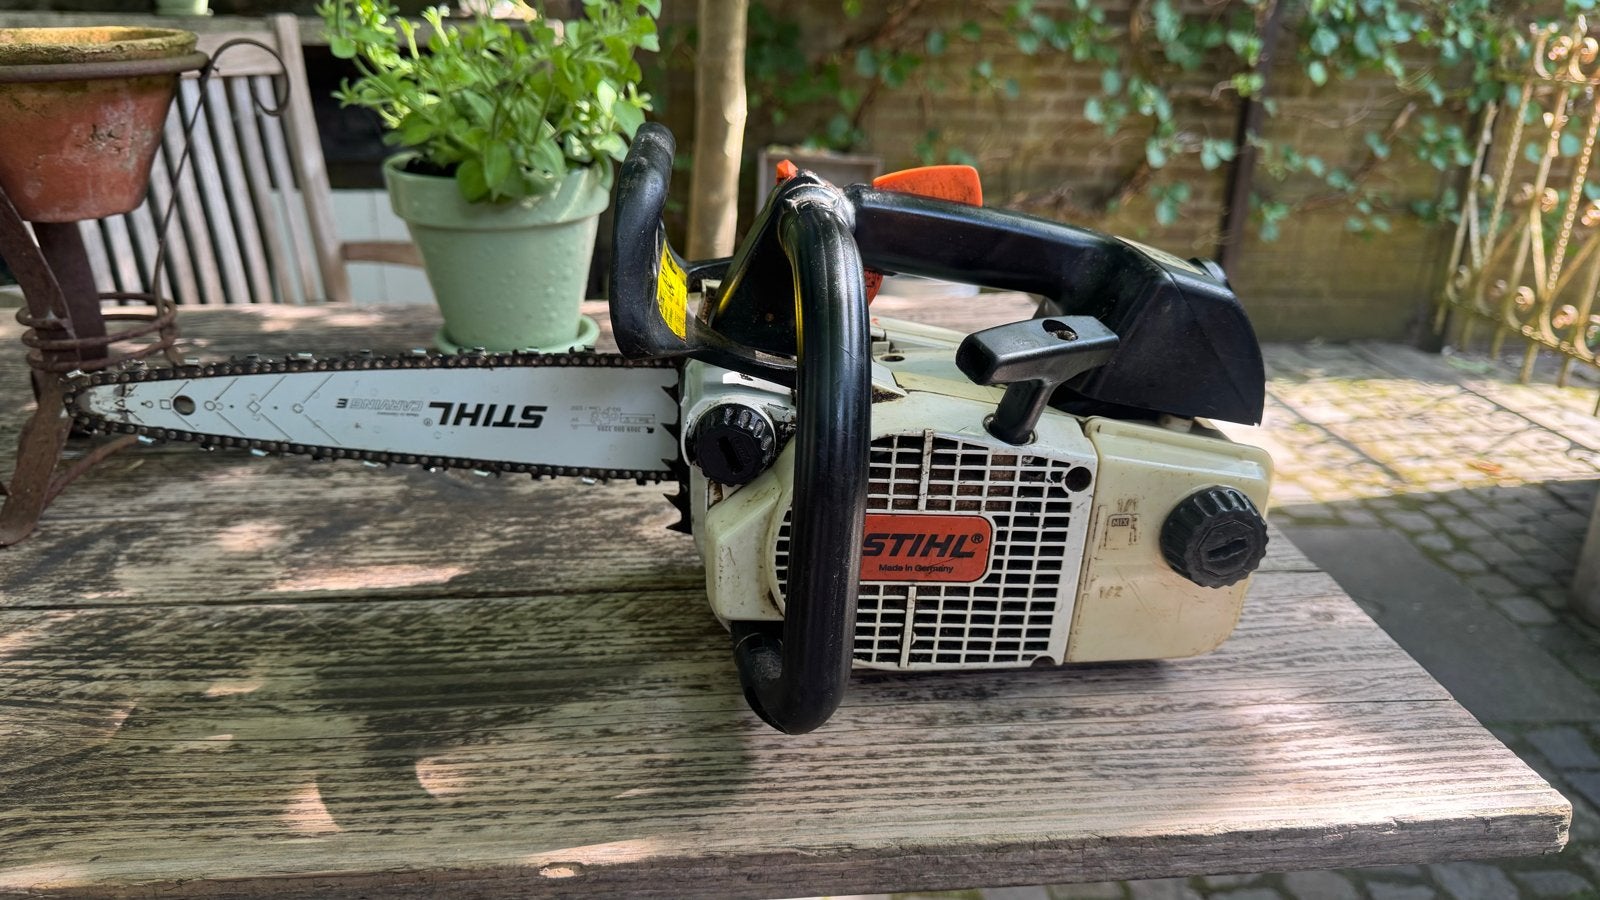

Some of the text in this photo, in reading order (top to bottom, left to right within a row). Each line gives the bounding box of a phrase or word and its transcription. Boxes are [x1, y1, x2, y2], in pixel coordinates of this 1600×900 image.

[336, 398, 424, 412] CARVING E
[1111, 518, 1130, 527] MIX
[879, 563, 903, 572] Made
[915, 564, 954, 574] Germany
